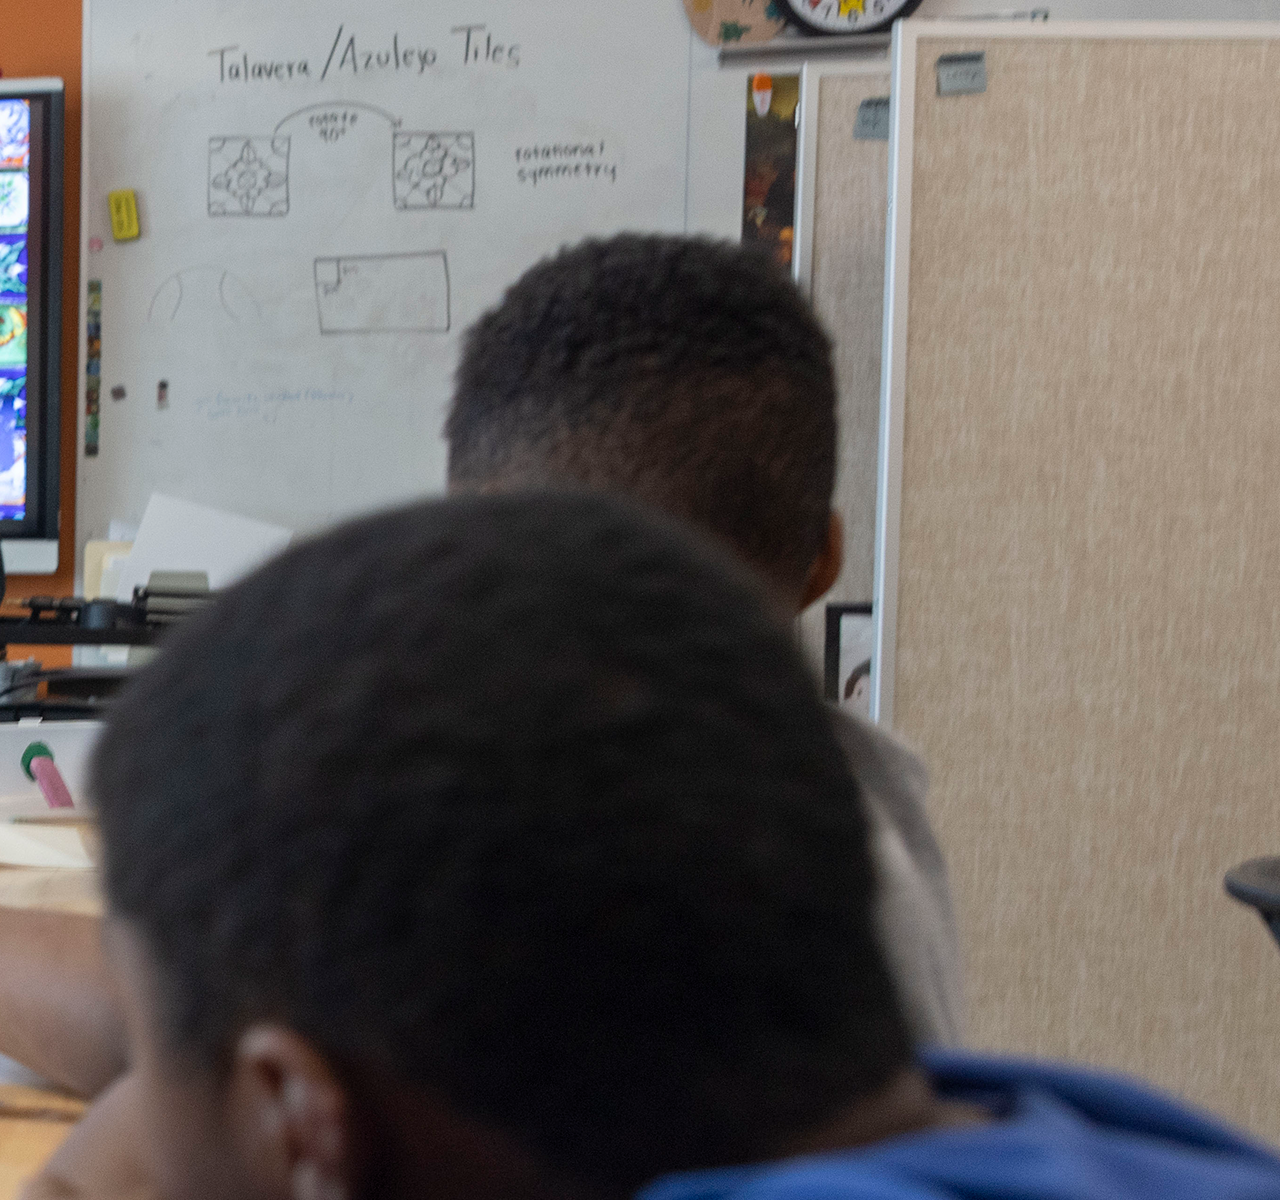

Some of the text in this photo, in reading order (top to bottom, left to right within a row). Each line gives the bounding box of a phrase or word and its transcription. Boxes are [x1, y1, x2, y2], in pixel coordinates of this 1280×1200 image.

[207, 43, 311, 83] Talavera
[450, 22, 521, 67] Tiles
[308, 111, 358, 128] rotate
[514, 140, 605, 163] rotational
[517, 162, 618, 187] symmetry
